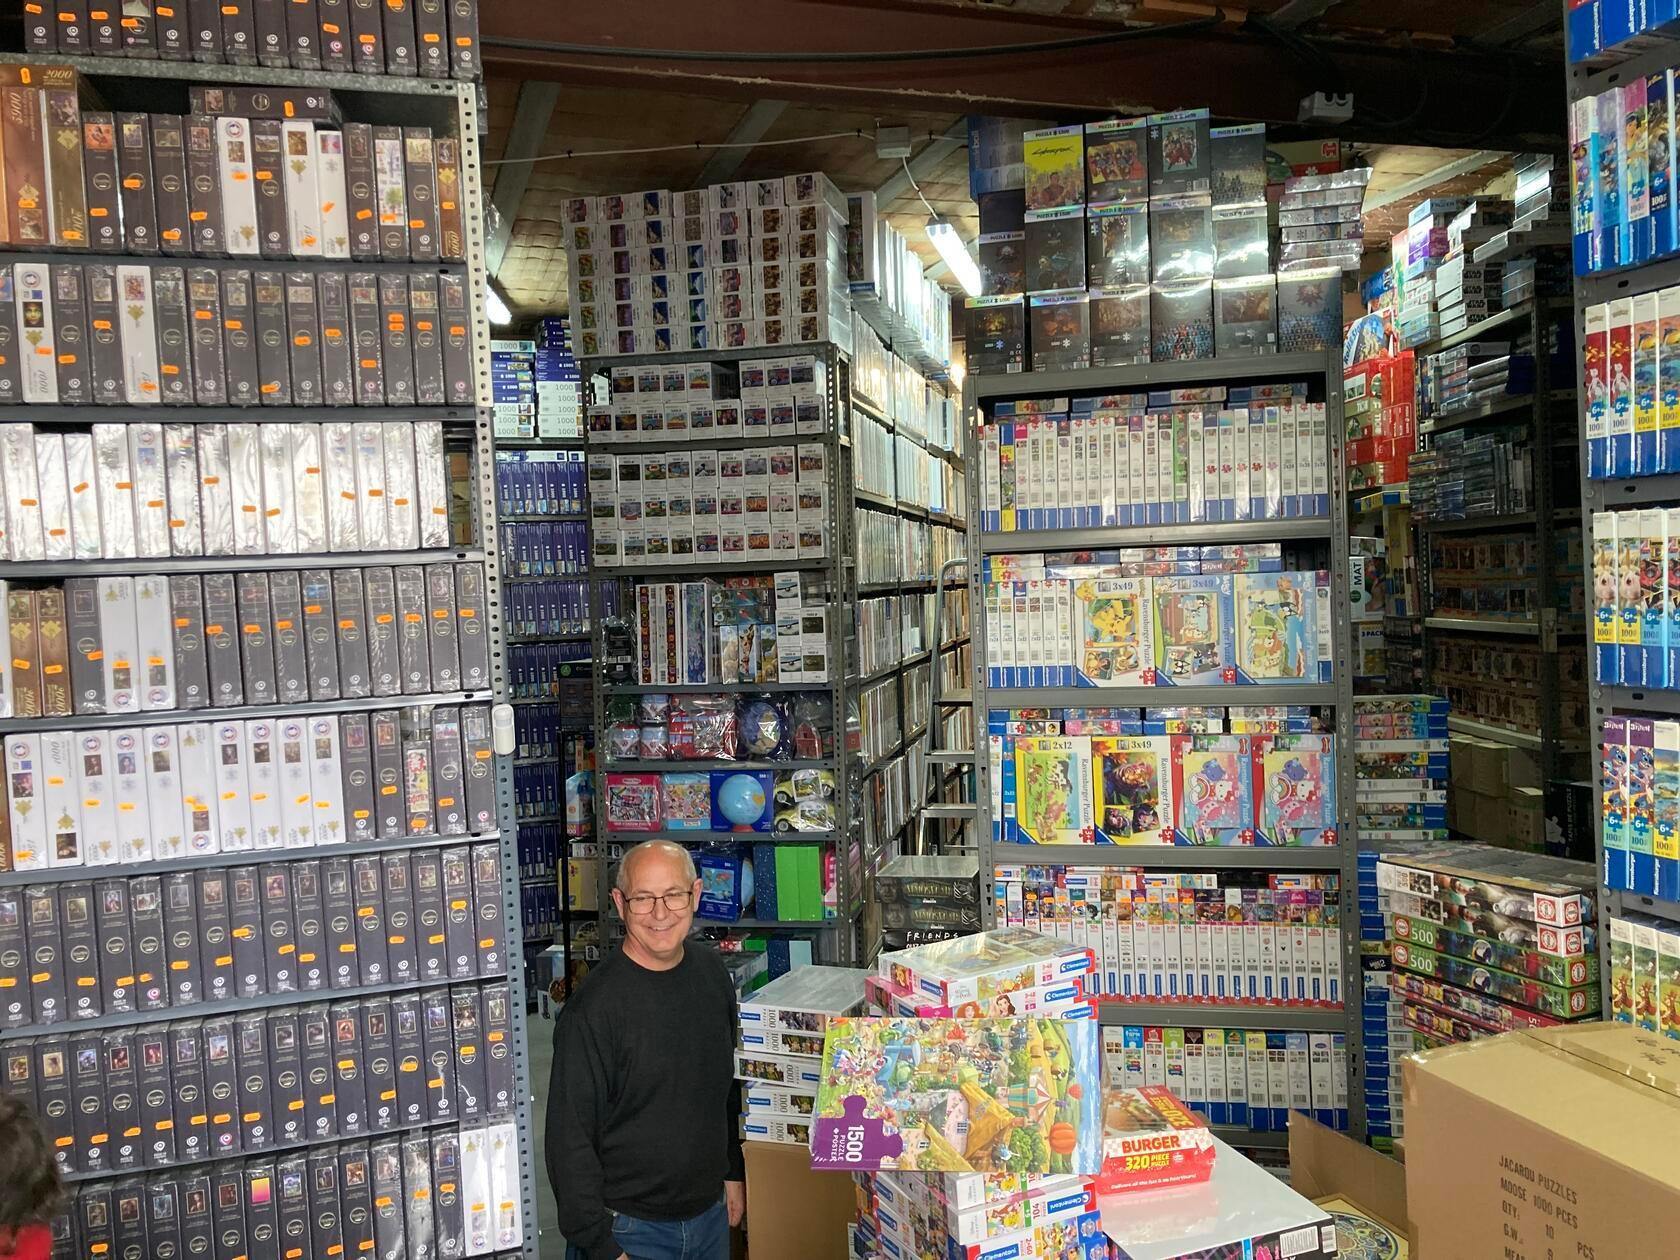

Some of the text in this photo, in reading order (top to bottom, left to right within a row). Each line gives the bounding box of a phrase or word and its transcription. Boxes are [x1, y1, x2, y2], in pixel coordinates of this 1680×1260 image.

[1036, 130, 1054, 138] PUZZLE
[1655, 177, 1664, 186] 6+
[1652, 196, 1664, 206] 100
[1641, 398, 1650, 407] 6+
[1666, 394, 1675, 403] 6+
[1592, 406, 1600, 415] 6+
[1616, 402, 1625, 411] 6+
[1638, 416, 1650, 425] 100
[1663, 412, 1675, 422] 100
[1589, 423, 1600, 432] 100
[1613, 419, 1625, 428] 100
[1354, 562, 1362, 586] MAT
[1112, 582, 1134, 591] 3x49
[1600, 611, 1609, 620] 6+
[1625, 611, 1633, 620] 6+
[1646, 613, 1656, 621] 6+
[1597, 628, 1609, 636] 100
[1621, 628, 1633, 637] 100
[1644, 631, 1655, 640] 100
[1053, 741, 1073, 750] 2x12
[1131, 741, 1153, 749] 3x49
[1081, 758, 1090, 802] Ravensburger
[1161, 758, 1171, 824] Ravensburger Puzzle
[1609, 816, 1620, 825] 6+
[1635, 820, 1645, 829] 6+
[1660, 824, 1671, 833] 6+
[1606, 833, 1618, 842] 100
[1632, 837, 1644, 846] 100
[1656, 841, 1670, 851] 100
[906, 931, 959, 942] FRIENDS
[1411, 929, 1434, 945] 500
[1067, 960, 1090, 969] Clementoni
[1410, 957, 1433, 972] 500
[1051, 989, 1077, 999] Clementoni
[1068, 1008, 1092, 1018] Clementoni
[780, 1094, 788, 1113] 1000
[830, 1134, 839, 1162] POSTER
[838, 1135, 846, 1161] PUZZLE
[845, 1125, 865, 1163] 1500
[1121, 1135, 1181, 1154] BURGER
[1151, 1153, 1170, 1161] PIECE
[1126, 1156, 1150, 1171] 320
[1499, 1155, 1578, 1206] JACAROU PUZZLES
[1050, 1195, 1083, 1210] Clementoni
[1500, 1177, 1579, 1230] MOOSE 1000 PCES
[1032, 1203, 1041, 1220] 104
[1545, 1224, 1555, 1240] 10
[1577, 1241, 1595, 1260] PCS
[984, 1247, 1017, 1260] Clementoni
